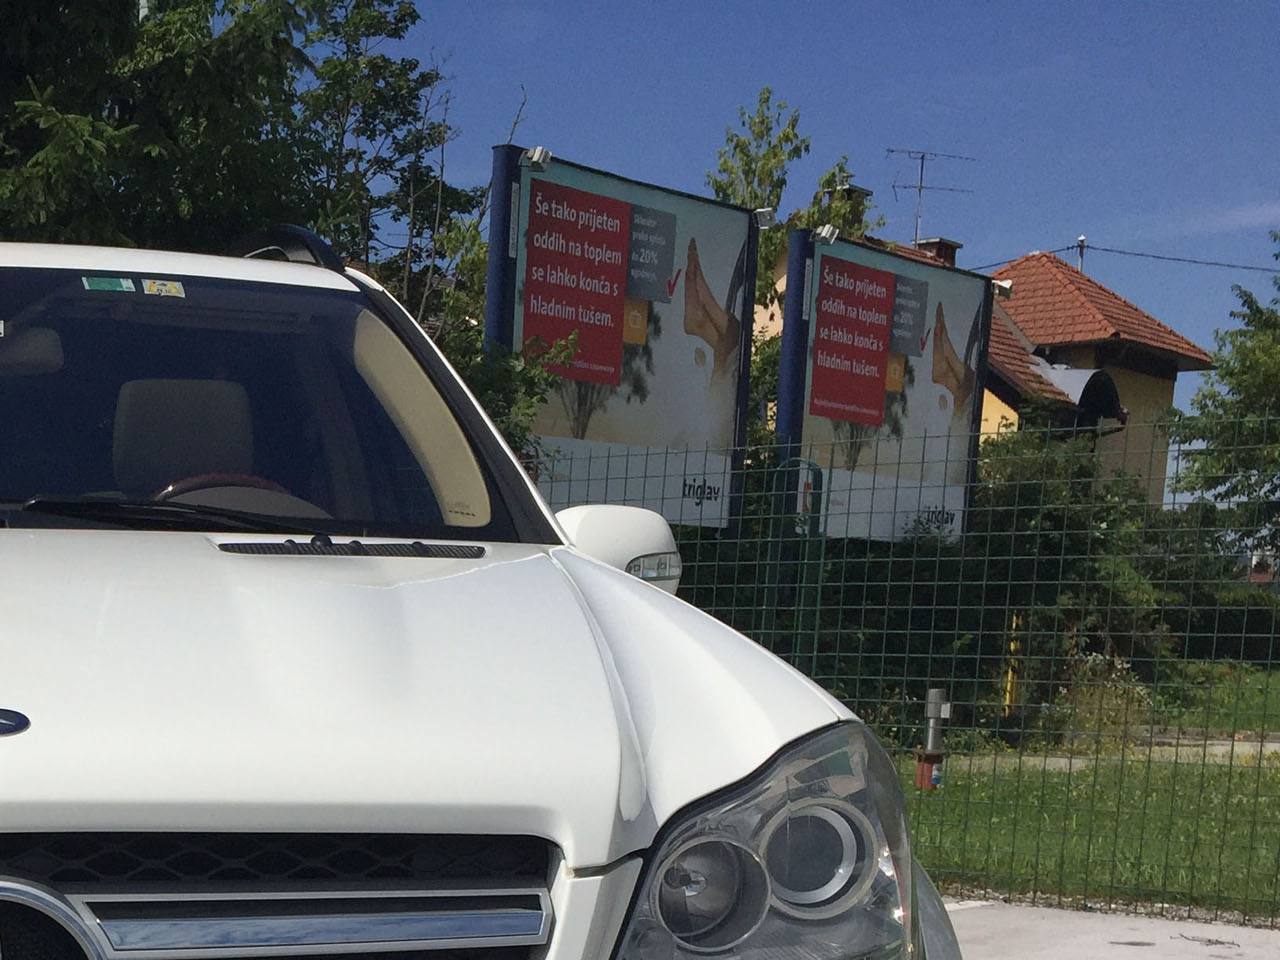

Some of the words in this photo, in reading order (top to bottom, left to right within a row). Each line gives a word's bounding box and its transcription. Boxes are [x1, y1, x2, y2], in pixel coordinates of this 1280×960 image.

[535, 192, 549, 216] Še
[551, 200, 577, 221] tako
[578, 209, 621, 232] prijeten
[533, 230, 566, 254] oddih
[568, 241, 582, 256] na
[584, 242, 622, 267] toplem
[531, 266, 544, 281] se
[547, 264, 577, 288] lahko
[579, 272, 611, 294] konča
[613, 283, 619, 297] s
[823, 265, 834, 286] Še
[835, 272, 855, 290] tako
[855, 279, 887, 299] prijeten
[530, 294, 576, 320] hladnim
[578, 305, 615, 327] tušem.
[821, 297, 846, 316] oddih
[847, 306, 858, 319] na
[858, 306, 888, 326] toplem
[819, 327, 829, 340] se
[830, 325, 853, 345] lahko
[878, 340, 884, 352] s
[817, 350, 851, 372] hladnim
[852, 359, 880, 378] tušem.
[682, 478, 721, 507] triglav
